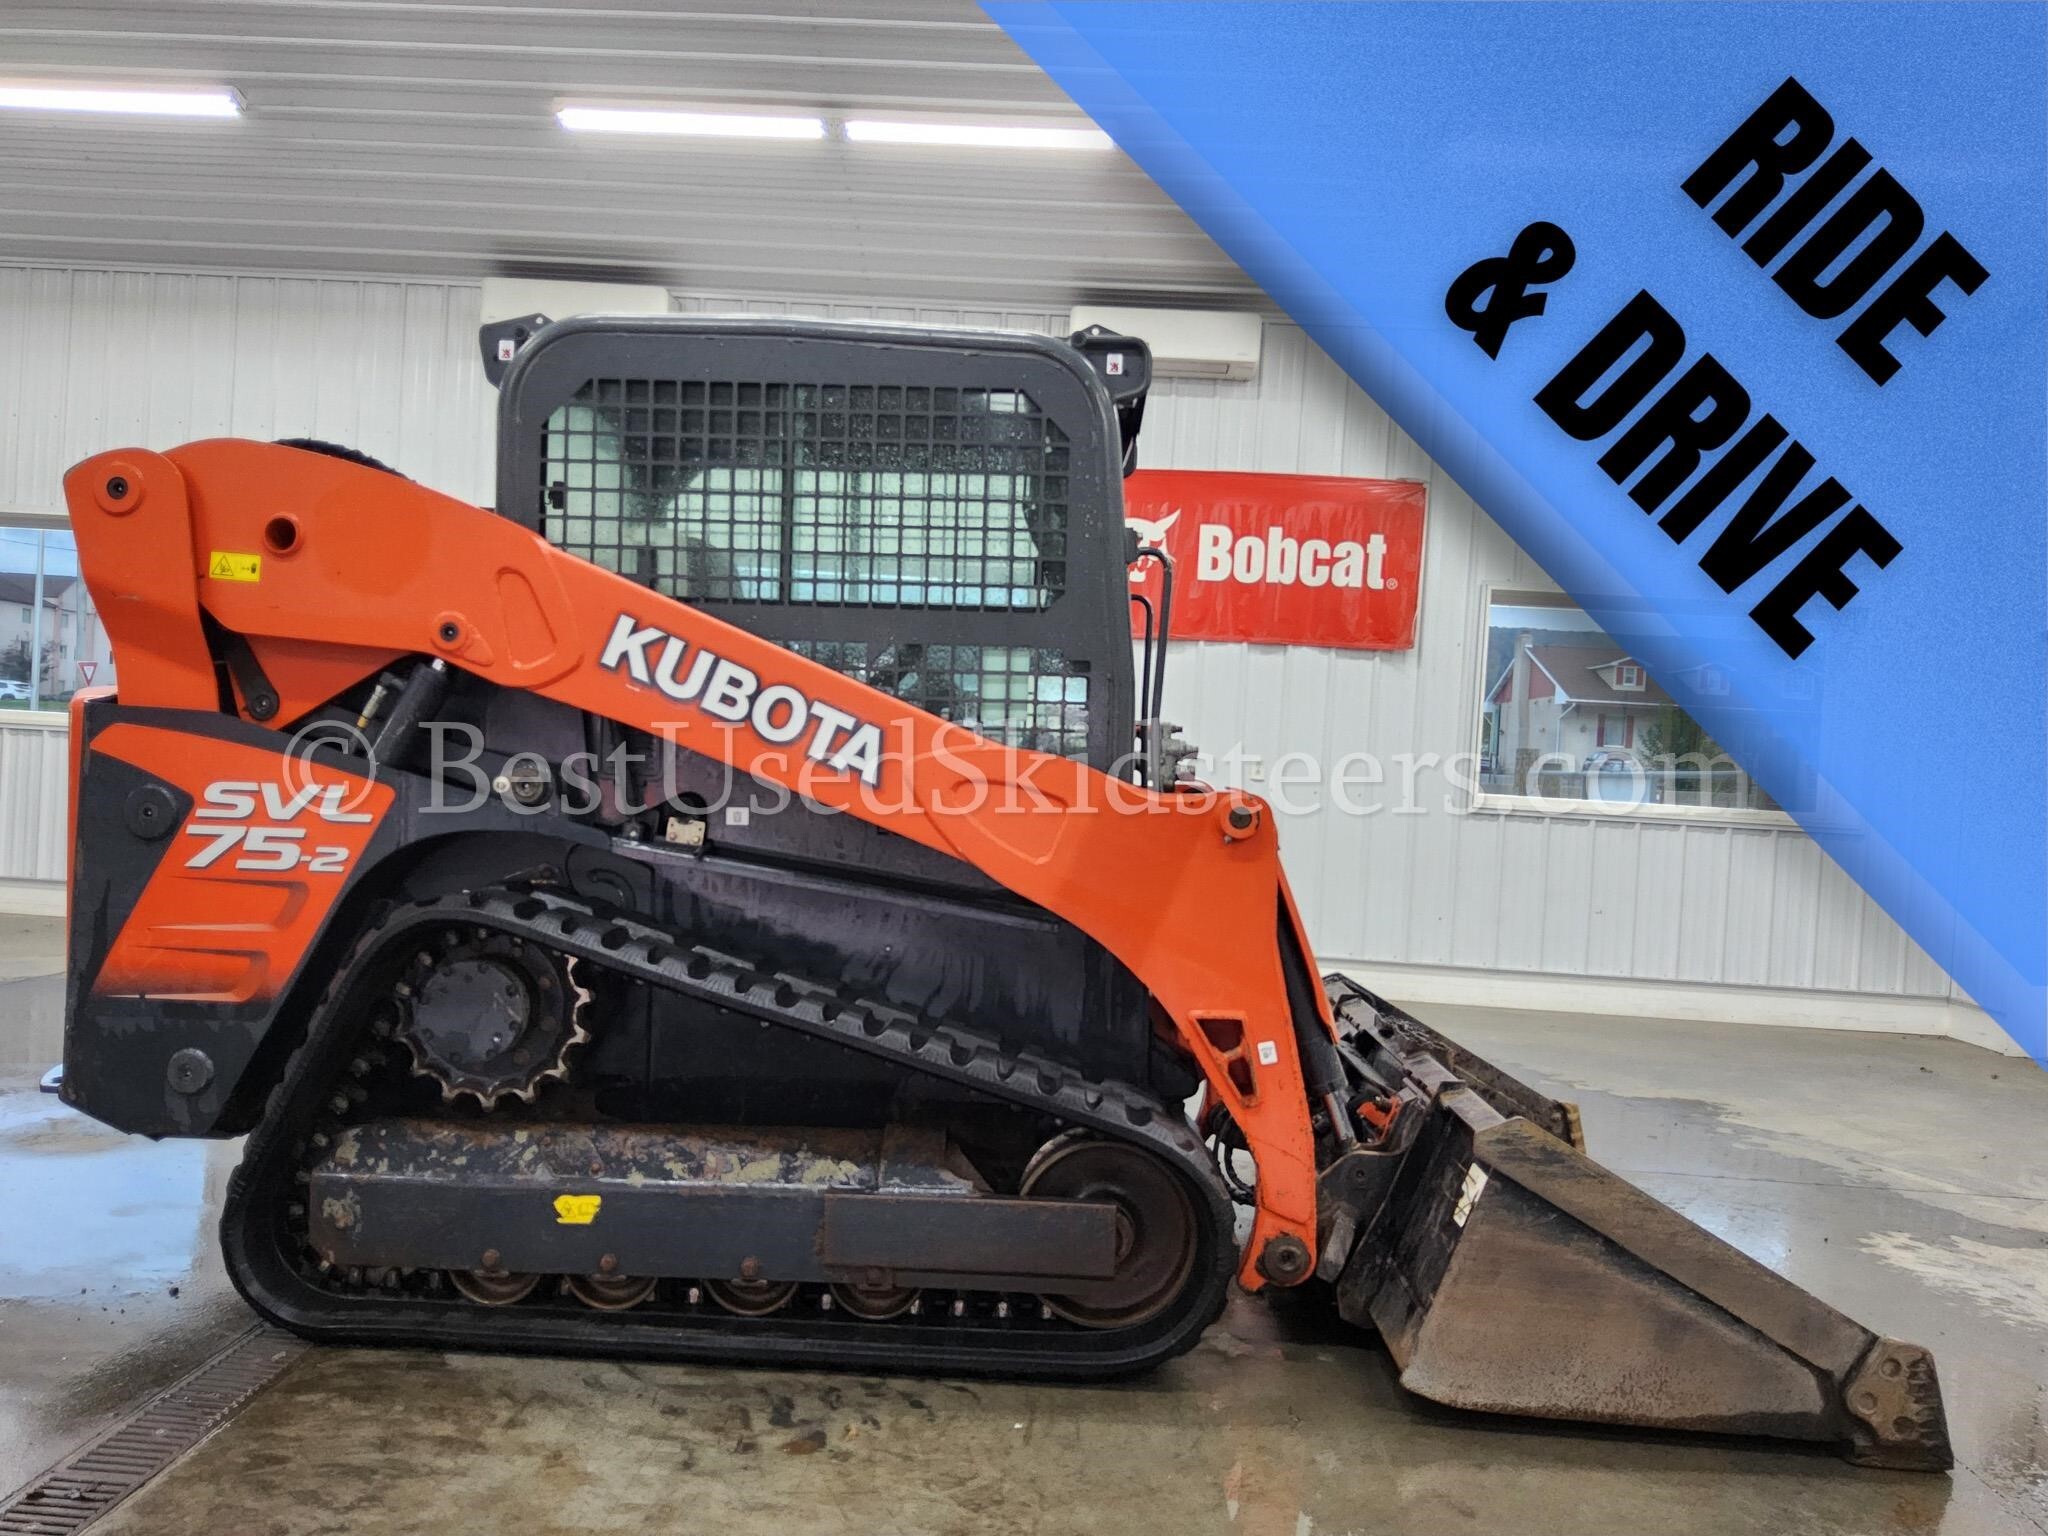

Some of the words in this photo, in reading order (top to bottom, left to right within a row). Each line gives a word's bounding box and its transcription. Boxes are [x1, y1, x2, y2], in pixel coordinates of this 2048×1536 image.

[600, 614, 881, 785] KUBOTA
[195, 781, 373, 823] SVL
[184, 824, 350, 872] 75-2
